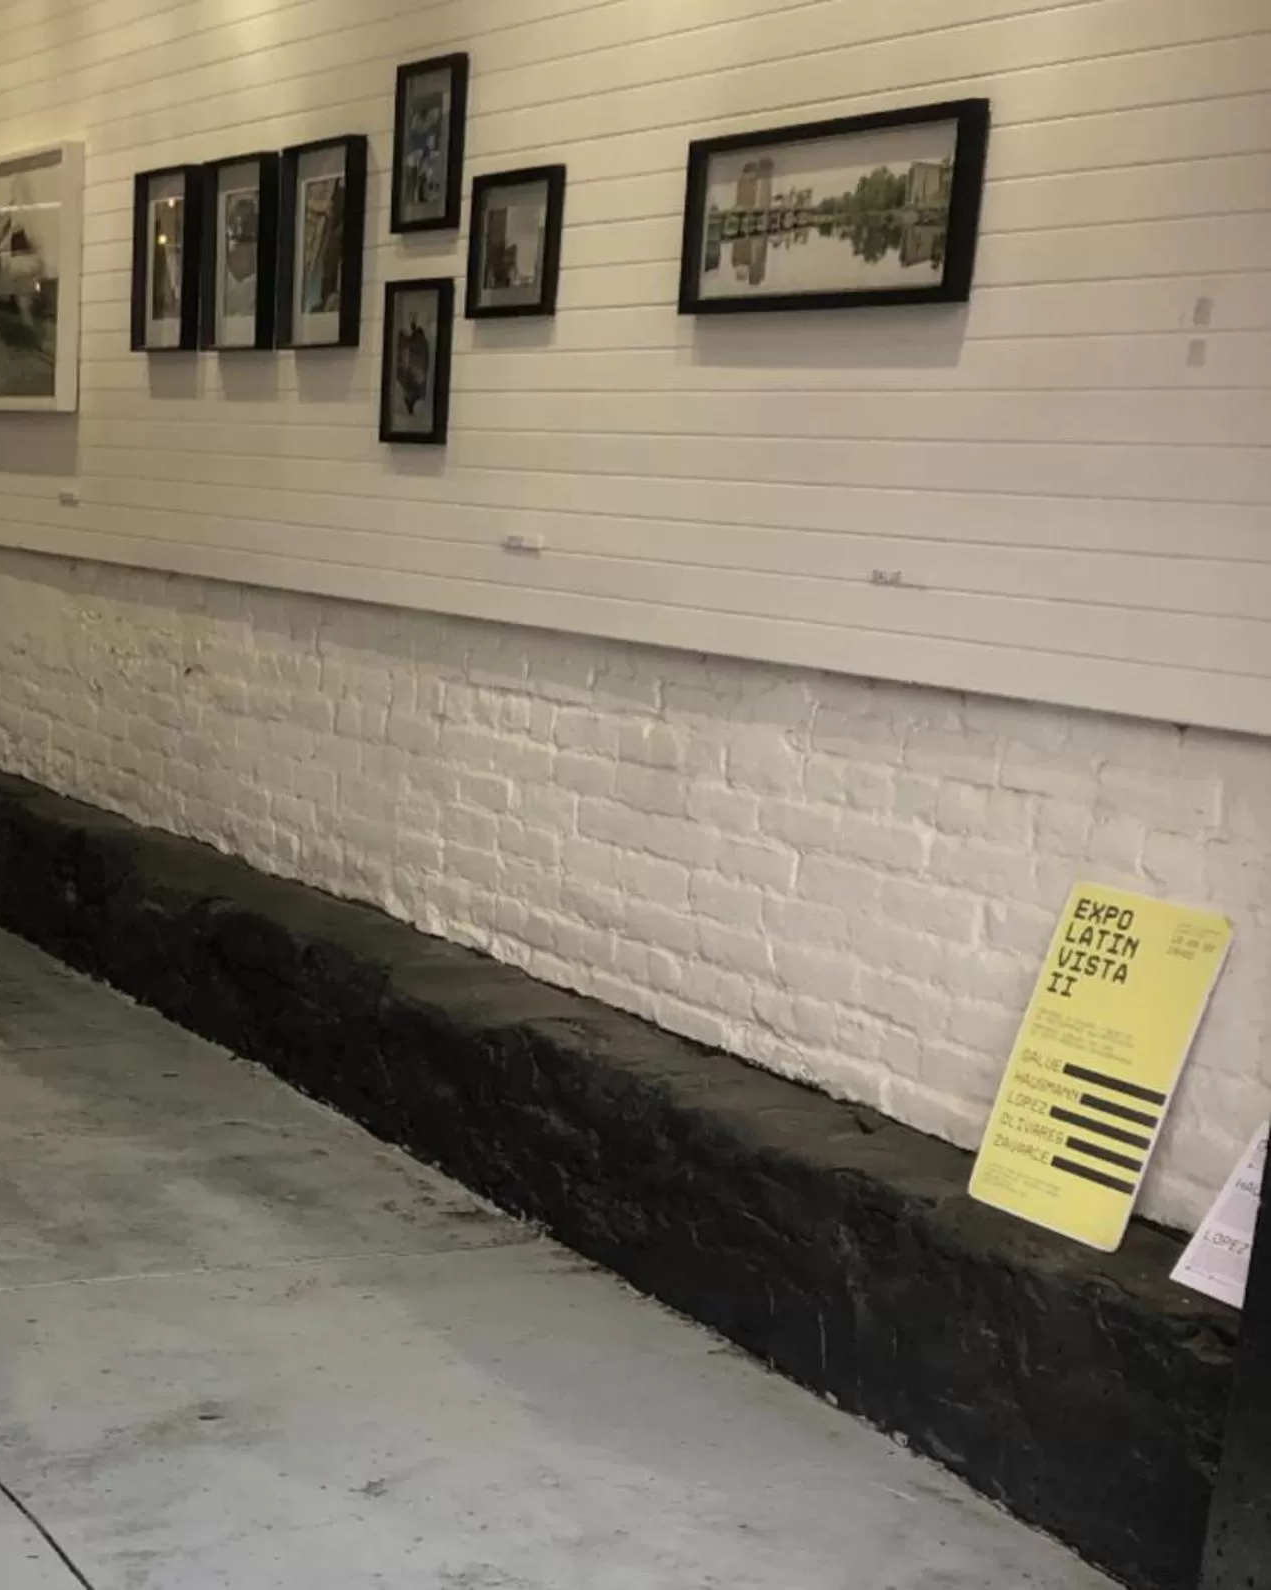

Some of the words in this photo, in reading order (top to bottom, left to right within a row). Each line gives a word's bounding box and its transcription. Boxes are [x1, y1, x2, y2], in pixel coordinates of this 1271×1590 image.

[1074, 898, 1134, 931] EXPO
[1065, 921, 1140, 960] LATIN
[1058, 945, 1128, 985] VISTA
[1046, 971, 1078, 998] II
[1006, 1090, 1049, 1116] LOPEZ
